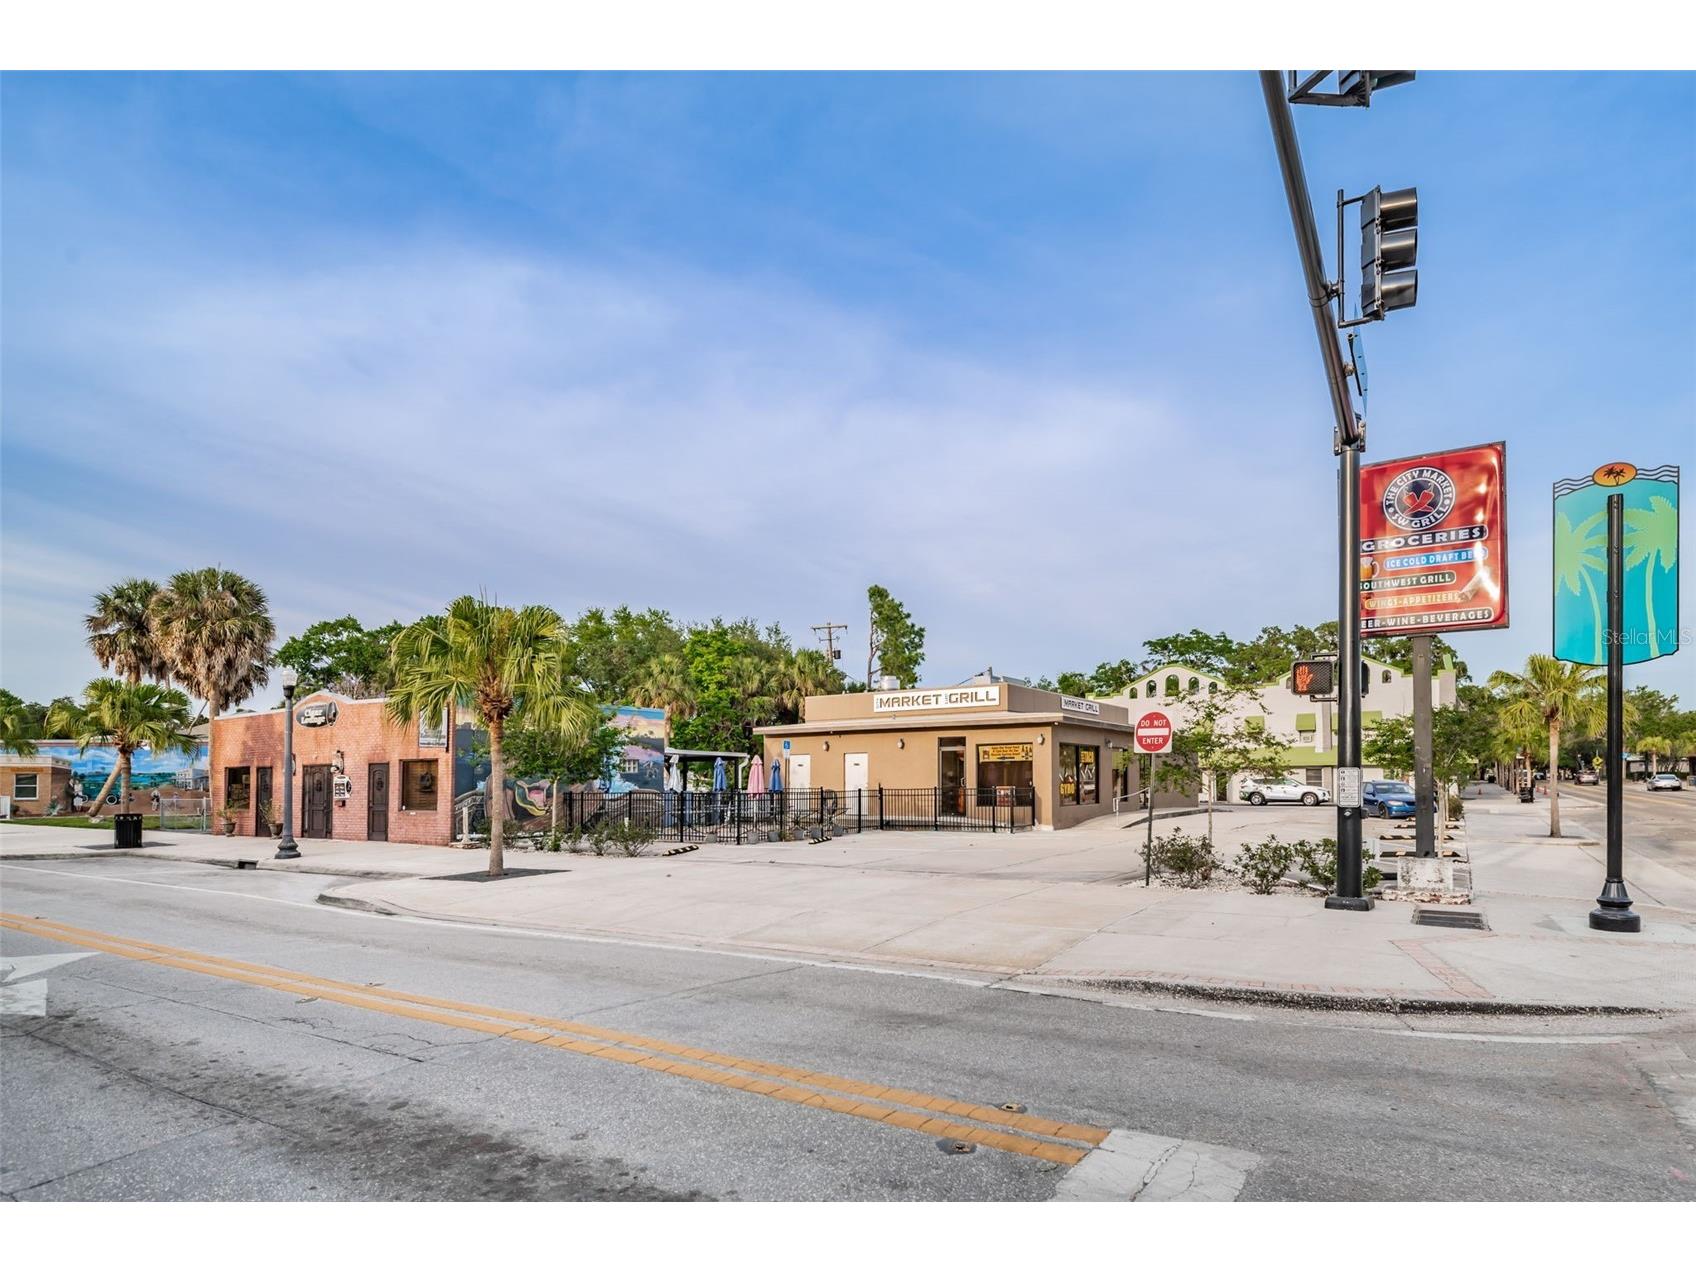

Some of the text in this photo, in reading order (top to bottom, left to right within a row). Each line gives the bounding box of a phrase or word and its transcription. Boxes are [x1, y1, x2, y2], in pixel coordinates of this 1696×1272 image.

[1385, 469, 1453, 505] THE CITY MARKET
[1391, 506, 1449, 528] SW GRILL
[1362, 527, 1481, 552] GROCERIES
[1386, 560, 1401, 568] ICE
[1402, 556, 1427, 566] COLD
[1429, 552, 1459, 564] DRAFT
[1420, 573, 1452, 584] GRILL
[1361, 609, 1490, 629] EER-WINE-BEVERAGES
[880, 694, 942, 708] MARKET
[948, 690, 996, 704] GRILL
[1063, 699, 1099, 712] MARKET GRILL
[1140, 719, 1167, 727] DO NOT
[1142, 737, 1164, 745] ENTER
